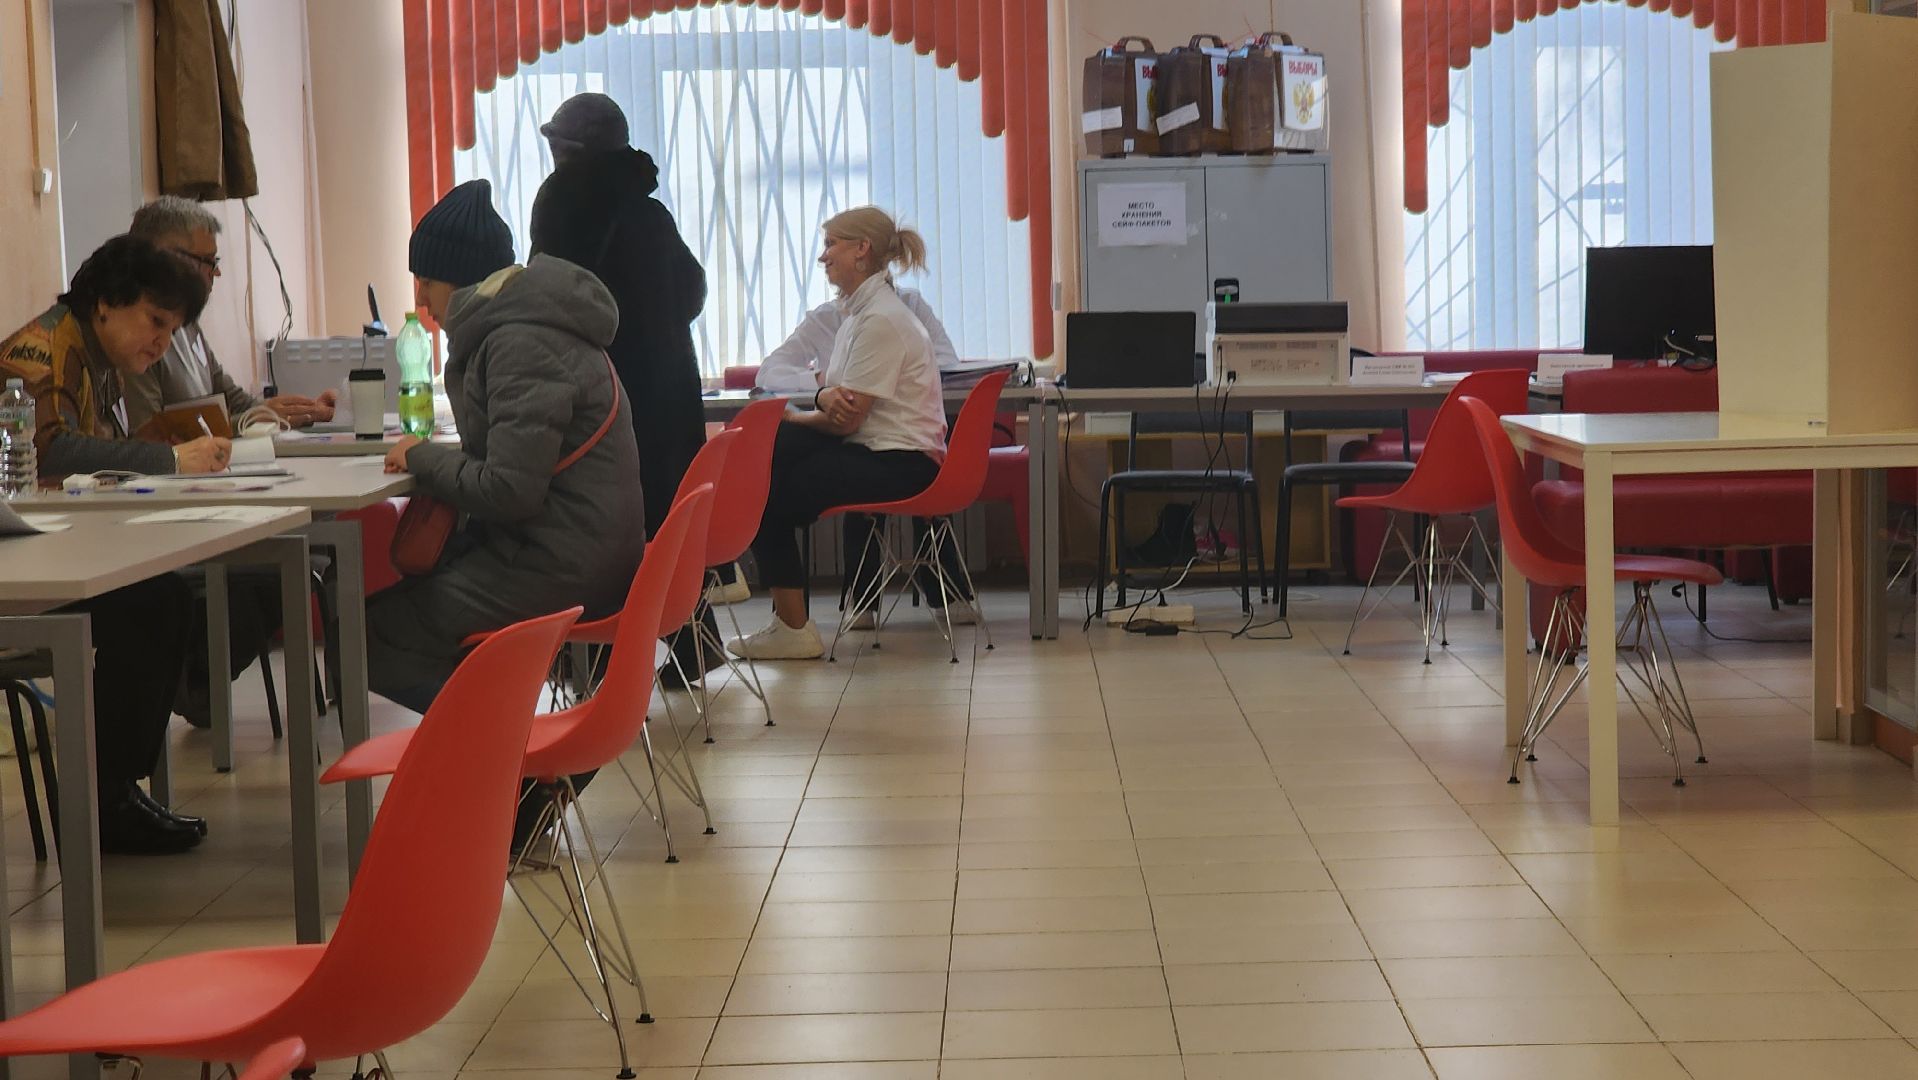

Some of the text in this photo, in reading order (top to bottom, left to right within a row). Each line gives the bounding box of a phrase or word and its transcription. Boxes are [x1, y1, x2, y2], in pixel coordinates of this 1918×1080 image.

[1288, 61, 1318, 75] ВЫБОРЫ
[1128, 202, 1155, 210] МЕСТО
[1112, 219, 1172, 228] СЕЙФ-ПАКЕТОВ
